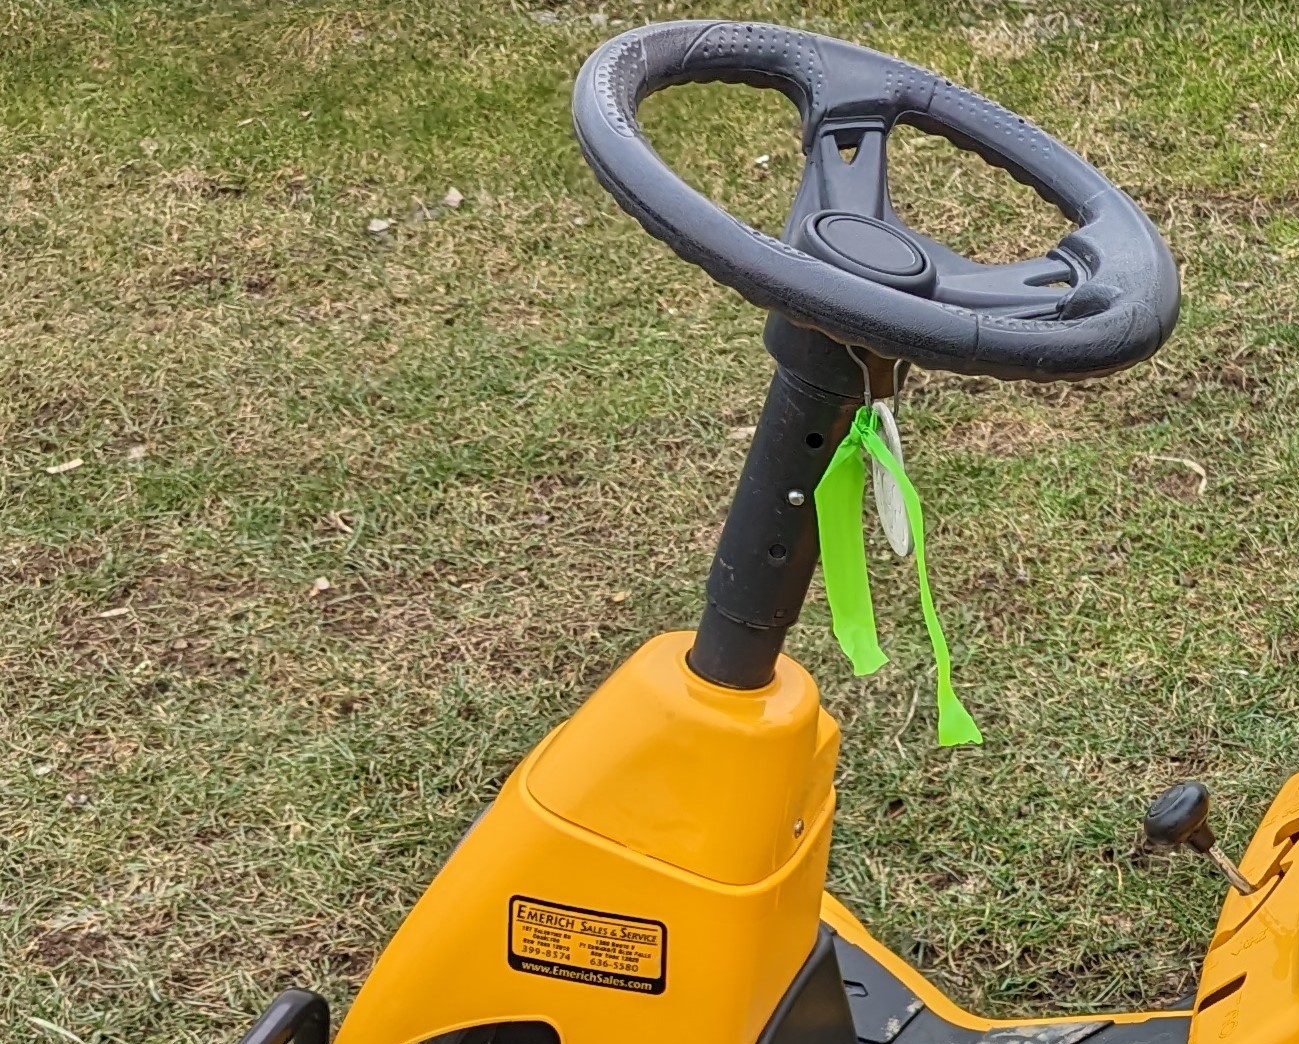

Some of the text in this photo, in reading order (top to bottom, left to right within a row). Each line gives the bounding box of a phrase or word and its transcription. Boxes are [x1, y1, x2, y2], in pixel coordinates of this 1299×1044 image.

[517, 903, 575, 929] EMERICH
[580, 921, 608, 935] SALES
[610, 929, 618, 937] &
[620, 927, 657, 943] SERVICE
[521, 944, 571, 961] 399-8574
[521, 961, 653, 991] www.EmerichSales.com
[590, 957, 639, 972] 636-5580
